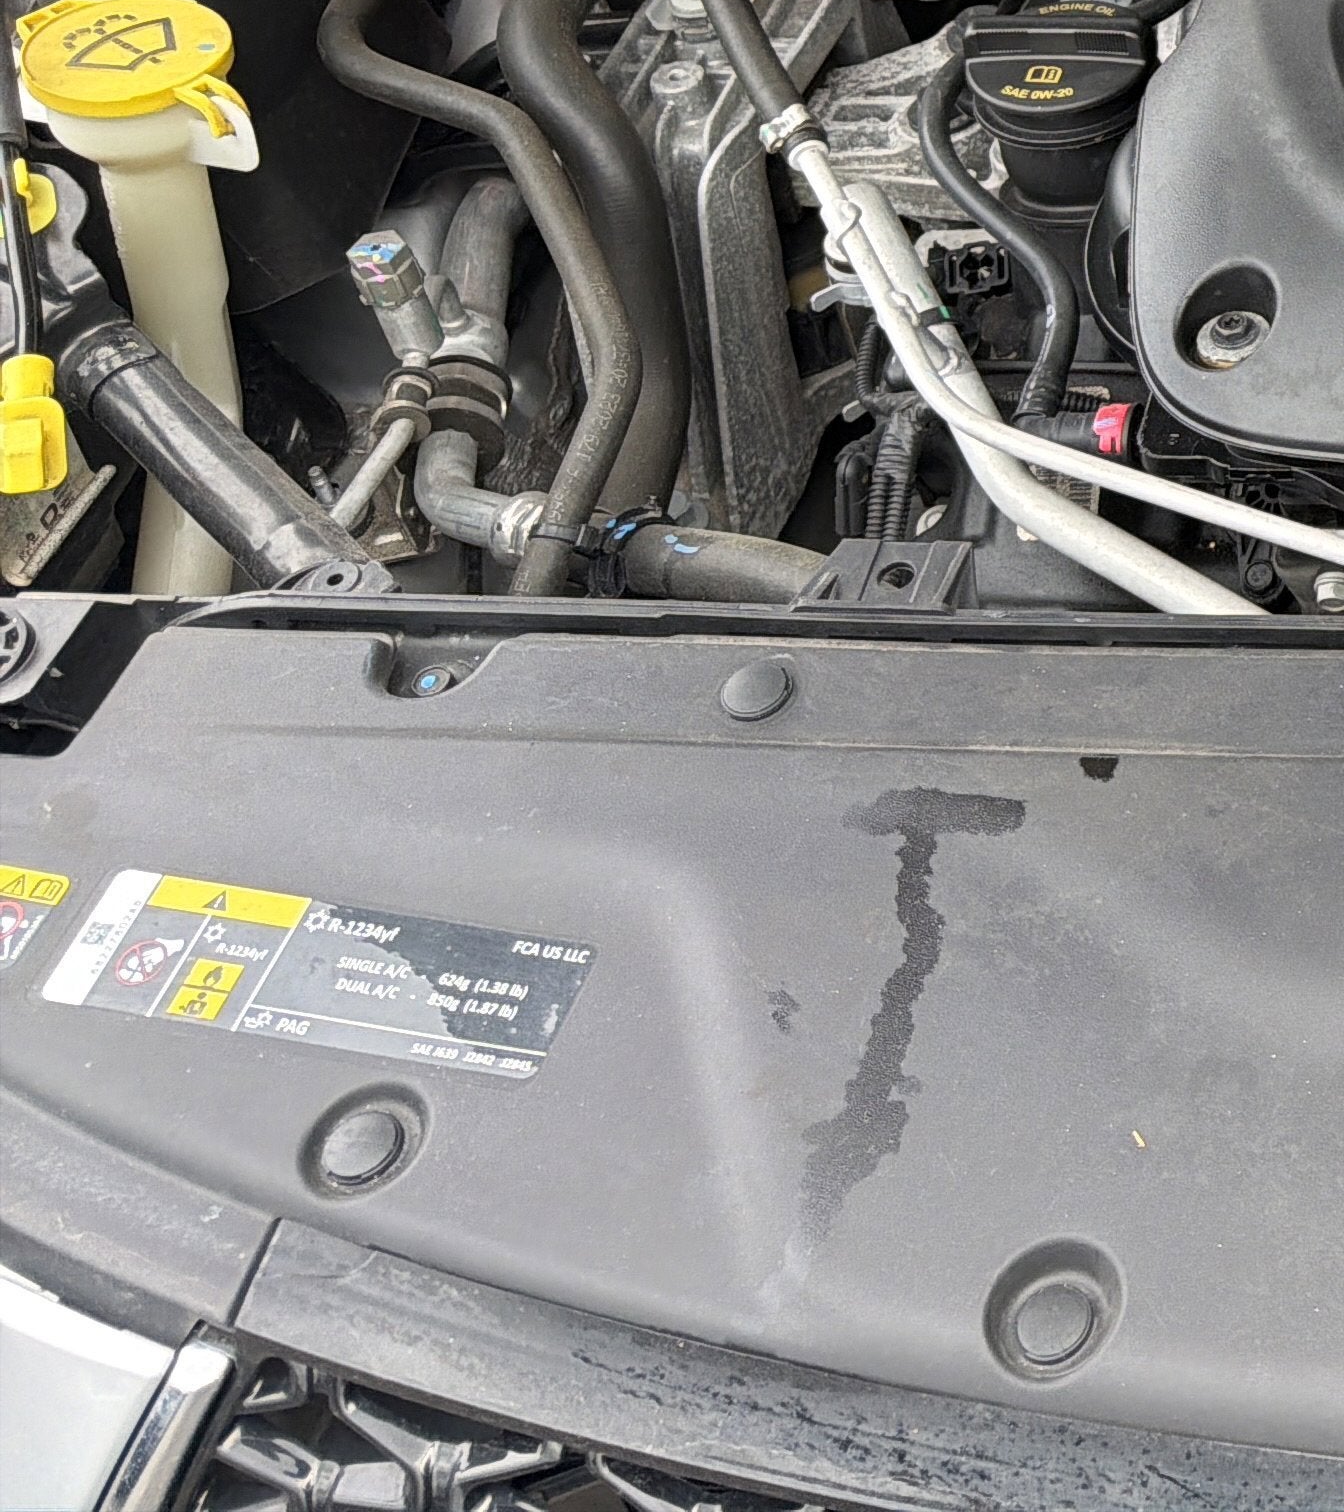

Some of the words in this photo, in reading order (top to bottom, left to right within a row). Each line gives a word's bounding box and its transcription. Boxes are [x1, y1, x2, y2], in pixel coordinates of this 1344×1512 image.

[1038, 3, 1092, 16] ENGINE
[1094, 3, 1117, 17] OIL
[1001, 85, 1029, 100] SAE
[1030, 87, 1074, 100] 0W-20
[327, 917, 401, 943] R-1234yf
[216, 942, 269, 962] R-1234yf
[512, 940, 540, 958] FCA
[542, 943, 564, 960] US
[562, 948, 591, 964] LLC
[336, 956, 386, 978] SINGLE
[383, 960, 412, 980] A/C
[438, 973, 471, 992] 624g
[473, 978, 511, 997] (1.38
[509, 982, 529, 1001] lb)
[335, 978, 374, 995] DUAL
[372, 982, 401, 1000] A/C
[426, 993, 459, 1012] 850g
[462, 998, 499, 1017] (1.87
[498, 1002, 519, 1021] lb)
[276, 1017, 309, 1036] PAG
[410, 1042, 433, 1056] SAE
